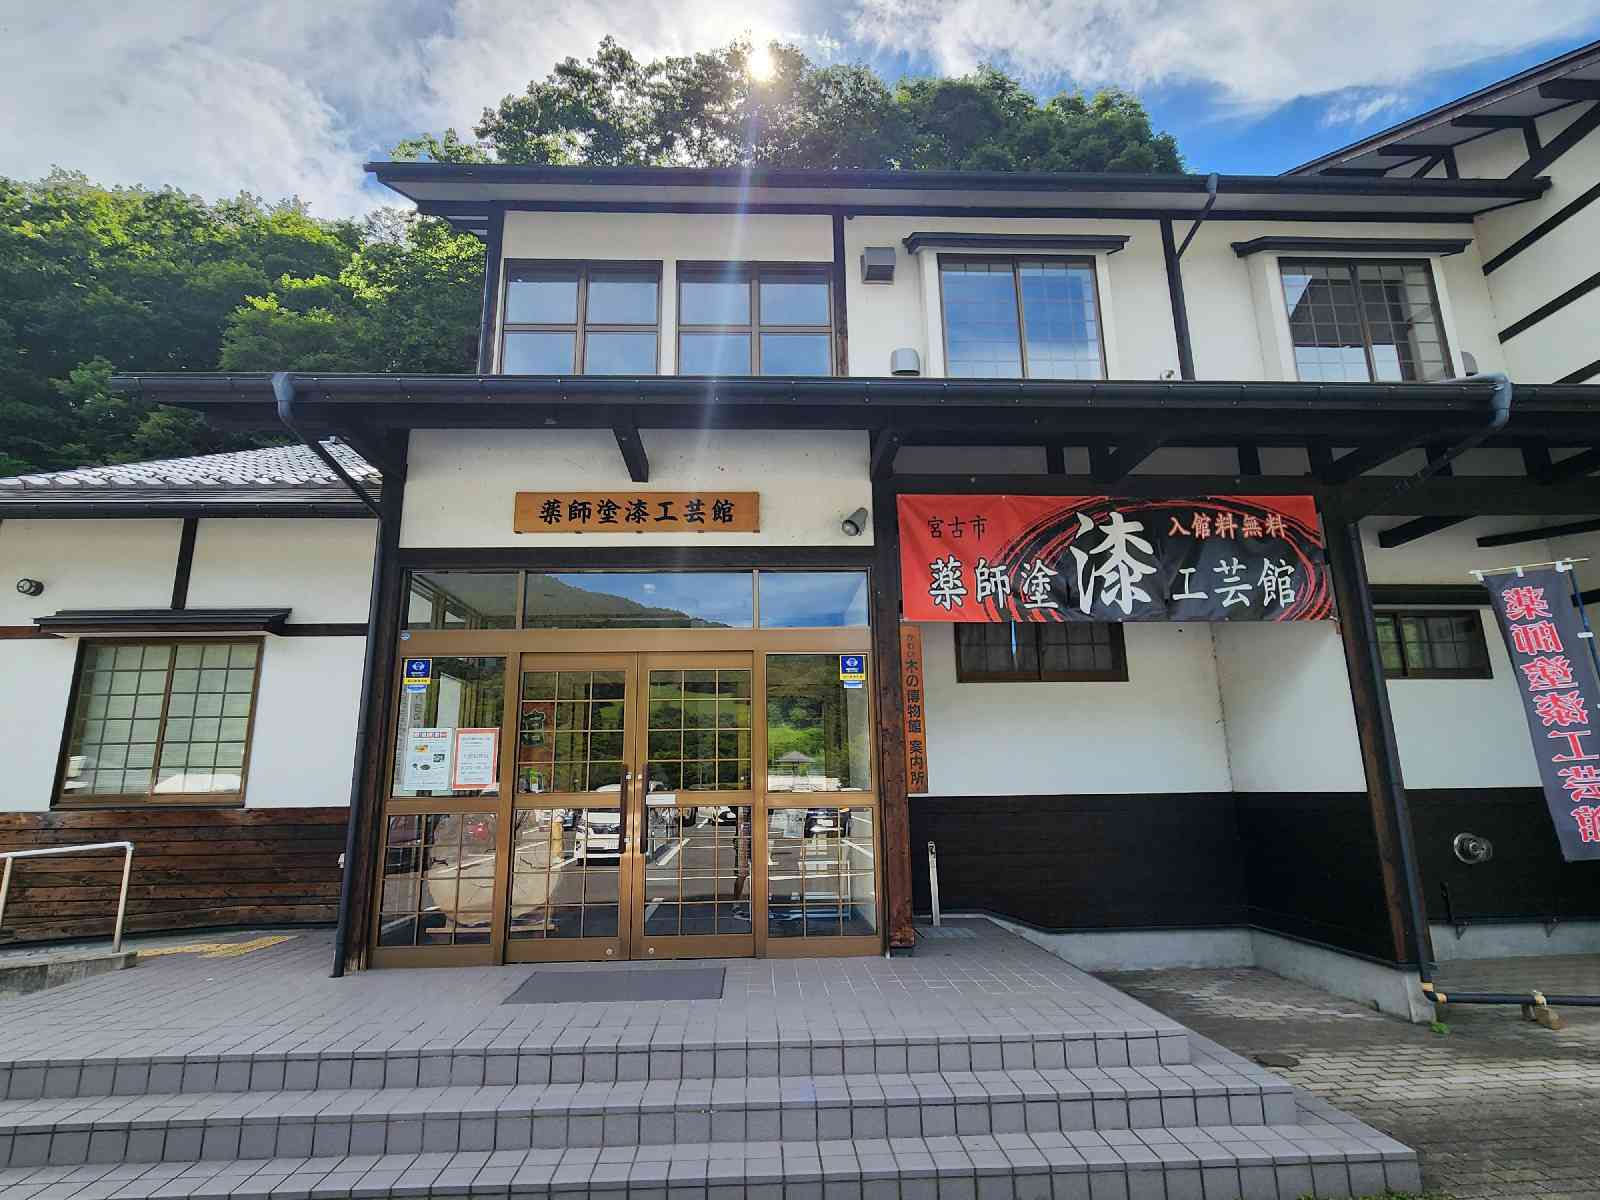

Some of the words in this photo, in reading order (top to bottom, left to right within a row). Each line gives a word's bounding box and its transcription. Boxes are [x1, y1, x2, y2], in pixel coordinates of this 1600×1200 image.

[539, 498, 735, 525] 薬師塗漆工芸館
[927, 514, 988, 541] 宮古市
[1167, 512, 1288, 540] 入館料無料
[928, 510, 1297, 615] 薬師塗漆工芸館
[905, 633, 922, 733] 木の博物館
[909, 740, 925, 785] 案内所
